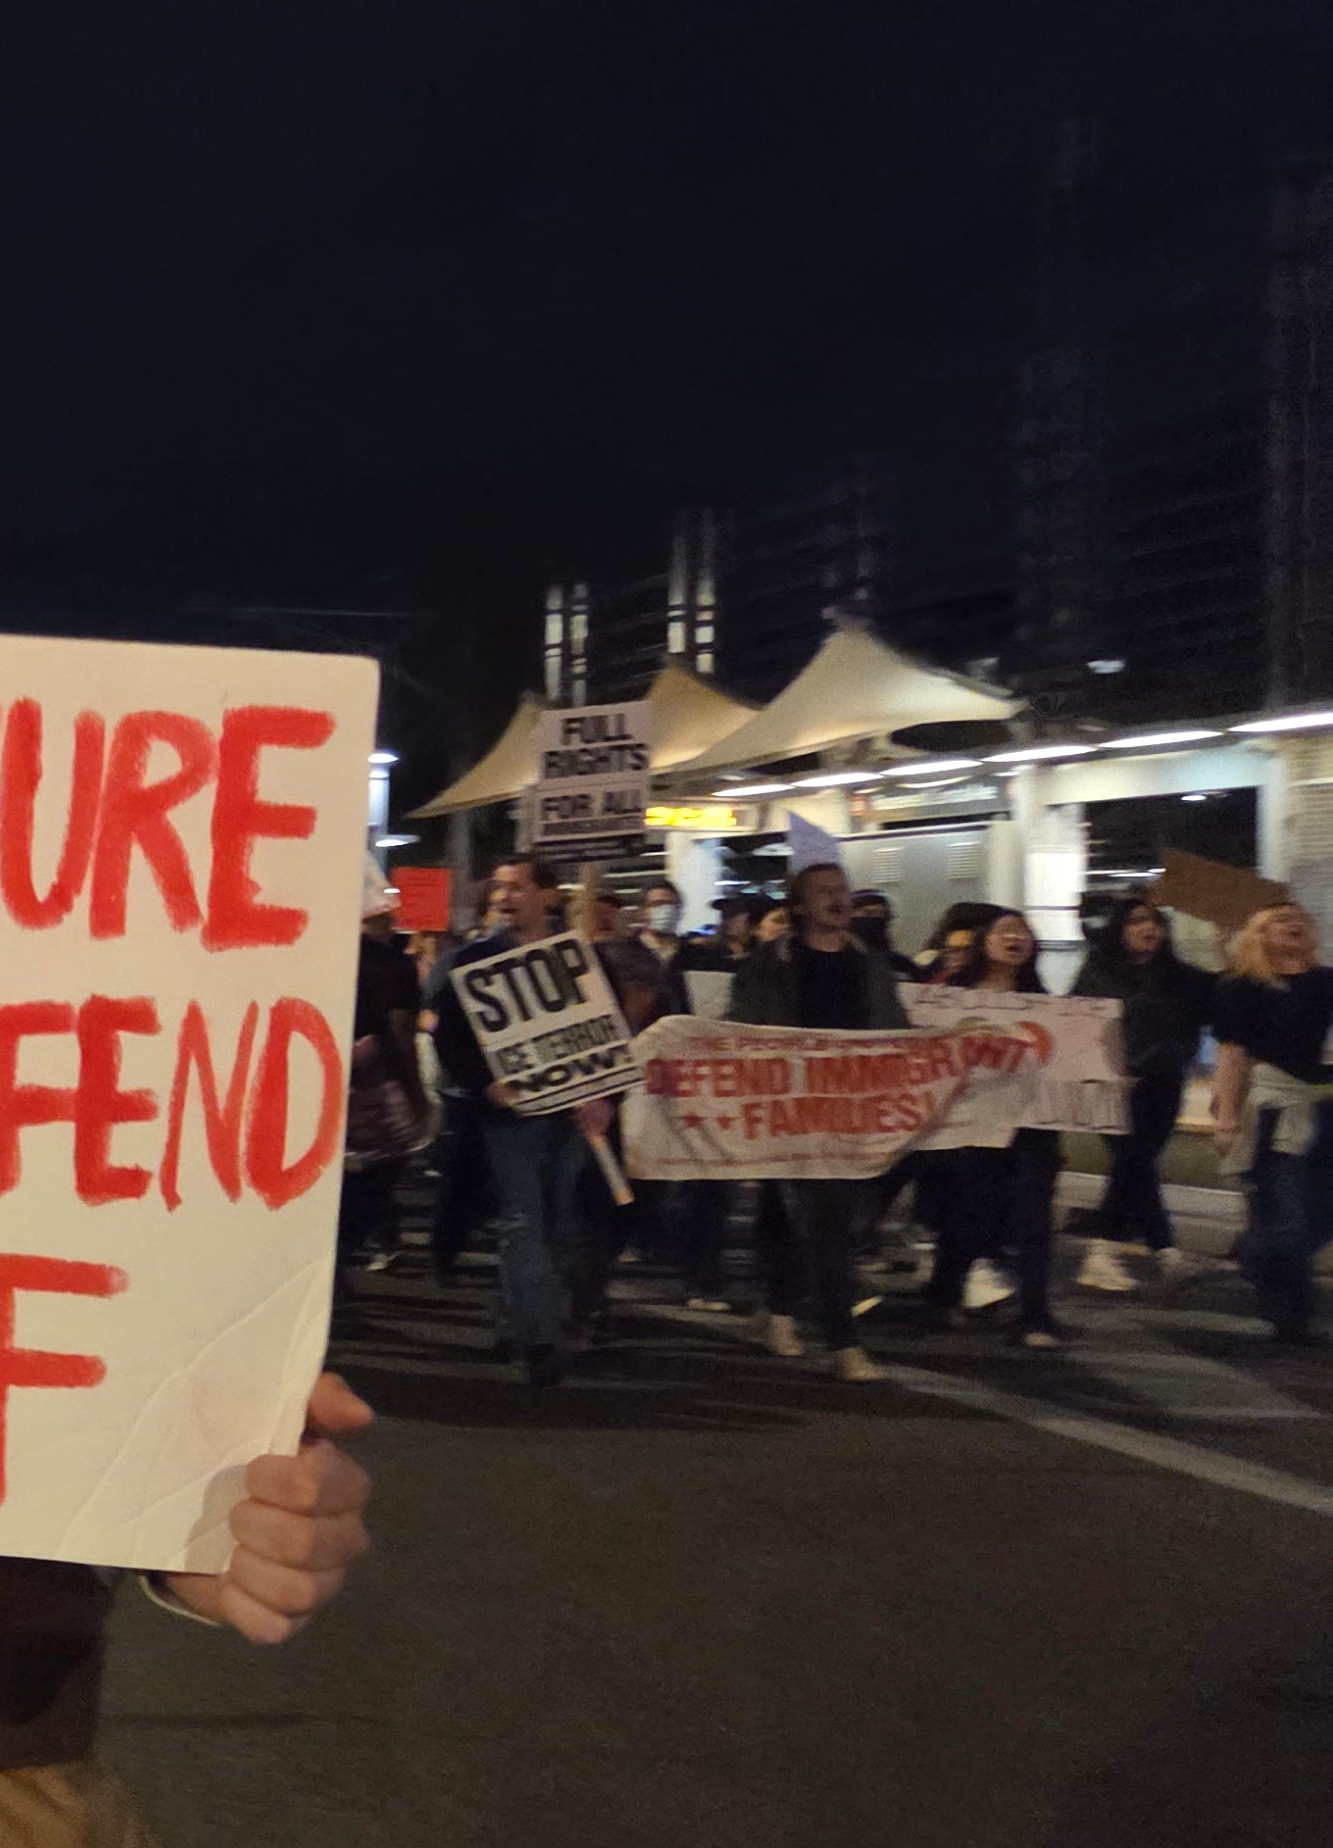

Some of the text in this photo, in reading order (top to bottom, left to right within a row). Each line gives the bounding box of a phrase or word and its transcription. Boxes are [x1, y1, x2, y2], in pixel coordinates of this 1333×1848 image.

[562, 713, 633, 745] FULL
[543, 743, 650, 780] RIGHTS
[540, 788, 643, 821] FOR ALL
[464, 938, 590, 1033] STOP
[496, 1014, 620, 1076] ICE TERROR
[505, 1043, 634, 1093] NOW!
[645, 1055, 791, 1098] DEFEND
[805, 1035, 1030, 1097] IMMIGRANT
[741, 1093, 933, 1141] FAMILIES!
